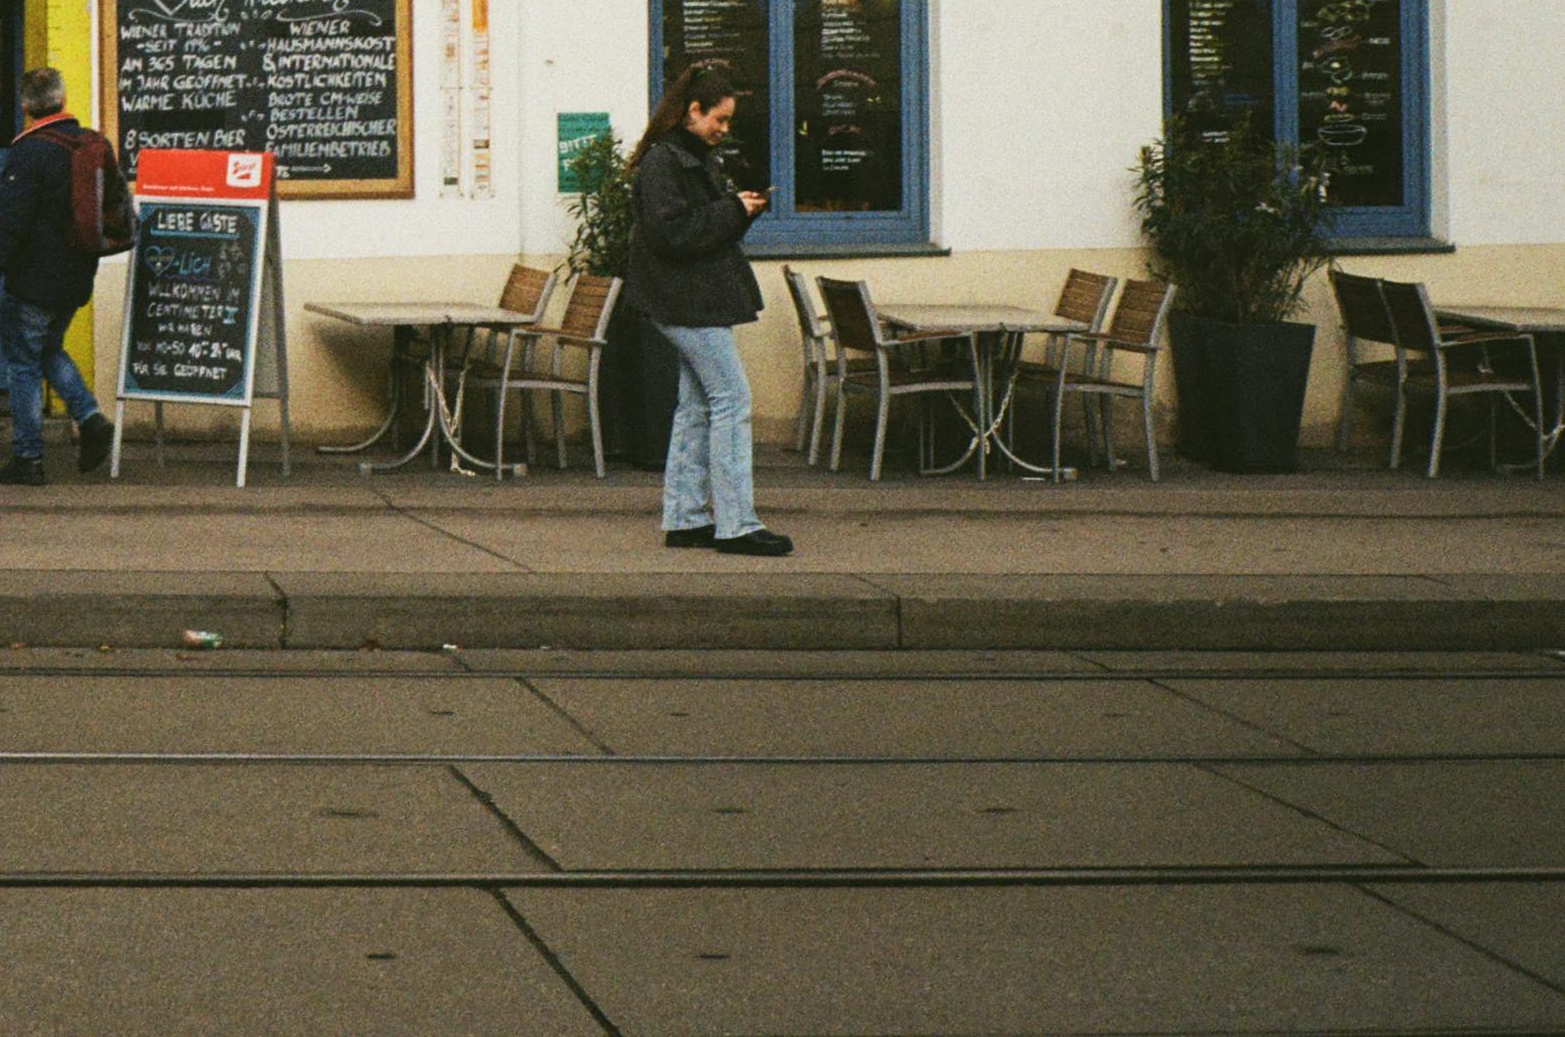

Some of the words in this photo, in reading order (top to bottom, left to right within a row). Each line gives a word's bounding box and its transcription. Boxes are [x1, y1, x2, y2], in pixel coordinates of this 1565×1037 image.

[290, 21, 351, 35] WIENER
[267, 36, 396, 53] HAUSMANNSKOST
[122, 57, 143, 72] AN
[148, 55, 175, 71] 365
[182, 54, 237, 71] TAGEN
[262, 53, 276, 73] &
[278, 52, 396, 71] INTERNATIONALE
[138, 76, 169, 92] JAHR
[270, 106, 359, 123] BESTELLEN
[124, 130, 137, 149] 8
[138, 130, 210, 149] SORTEN
[213, 129, 245, 148] BIER
[157, 212, 195, 231] LIEBE
